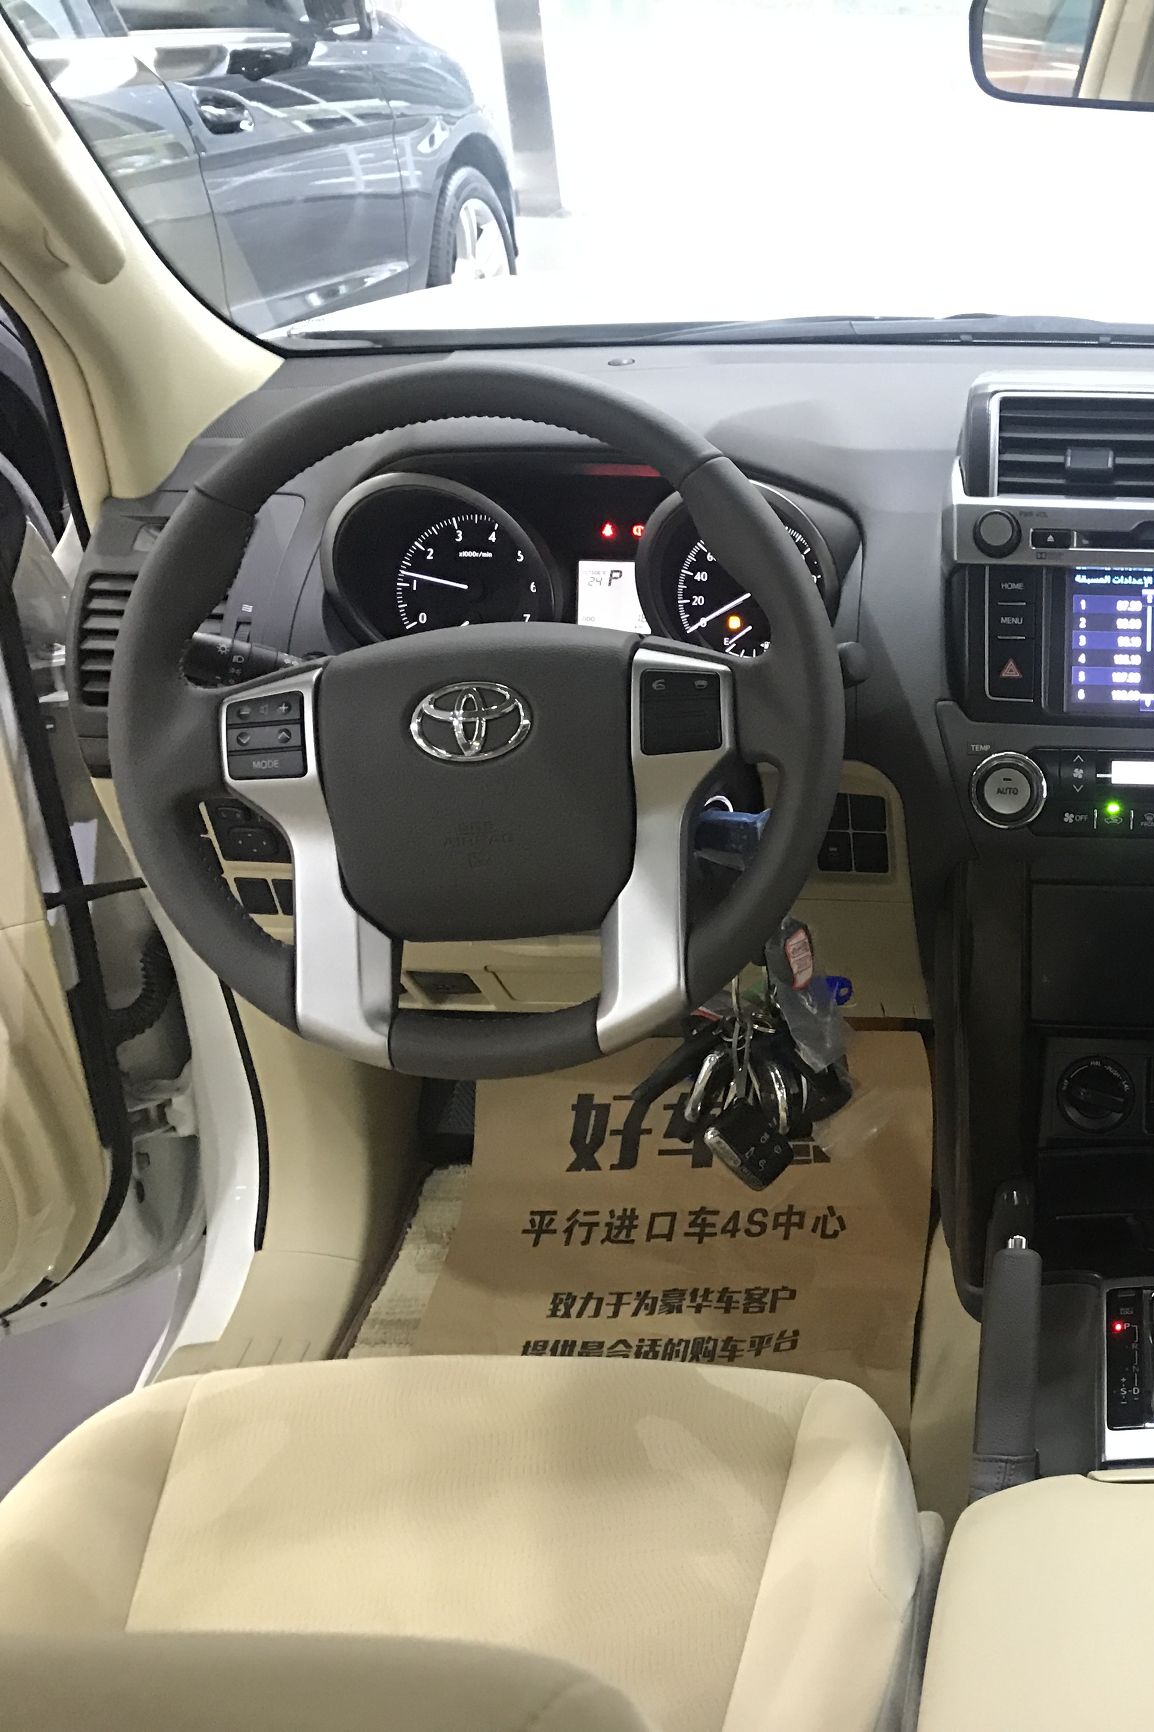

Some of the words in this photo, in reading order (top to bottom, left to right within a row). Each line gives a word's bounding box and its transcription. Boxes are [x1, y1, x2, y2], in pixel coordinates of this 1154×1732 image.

[455, 530, 463, 542] 3
[488, 531, 497, 542] 4
[426, 548, 434, 559] 2
[516, 550, 524, 562] 5
[607, 569, 623, 587] P
[694, 571, 708, 582] 40
[412, 579, 417, 591] 1
[530, 582, 537, 593] 6
[1001, 582, 1024, 590] HOME
[691, 596, 705, 606] 20
[418, 612, 427, 624] 0
[523, 613, 531, 622] 7
[1000, 616, 1023, 625] MENU
[970, 744, 991, 752] TEMP
[252, 760, 280, 769] MODE
[996, 786, 1019, 796] AUTO
[1074, 814, 1088, 822] OFF
[521, 1204, 847, 1247] 平行进口车4S中心
[547, 1286, 797, 1319] 致力于为豪华车客户
[1123, 1322, 1131, 1330] P
[1120, 1387, 1128, 1395] S
[1132, 1387, 1140, 1395] D
